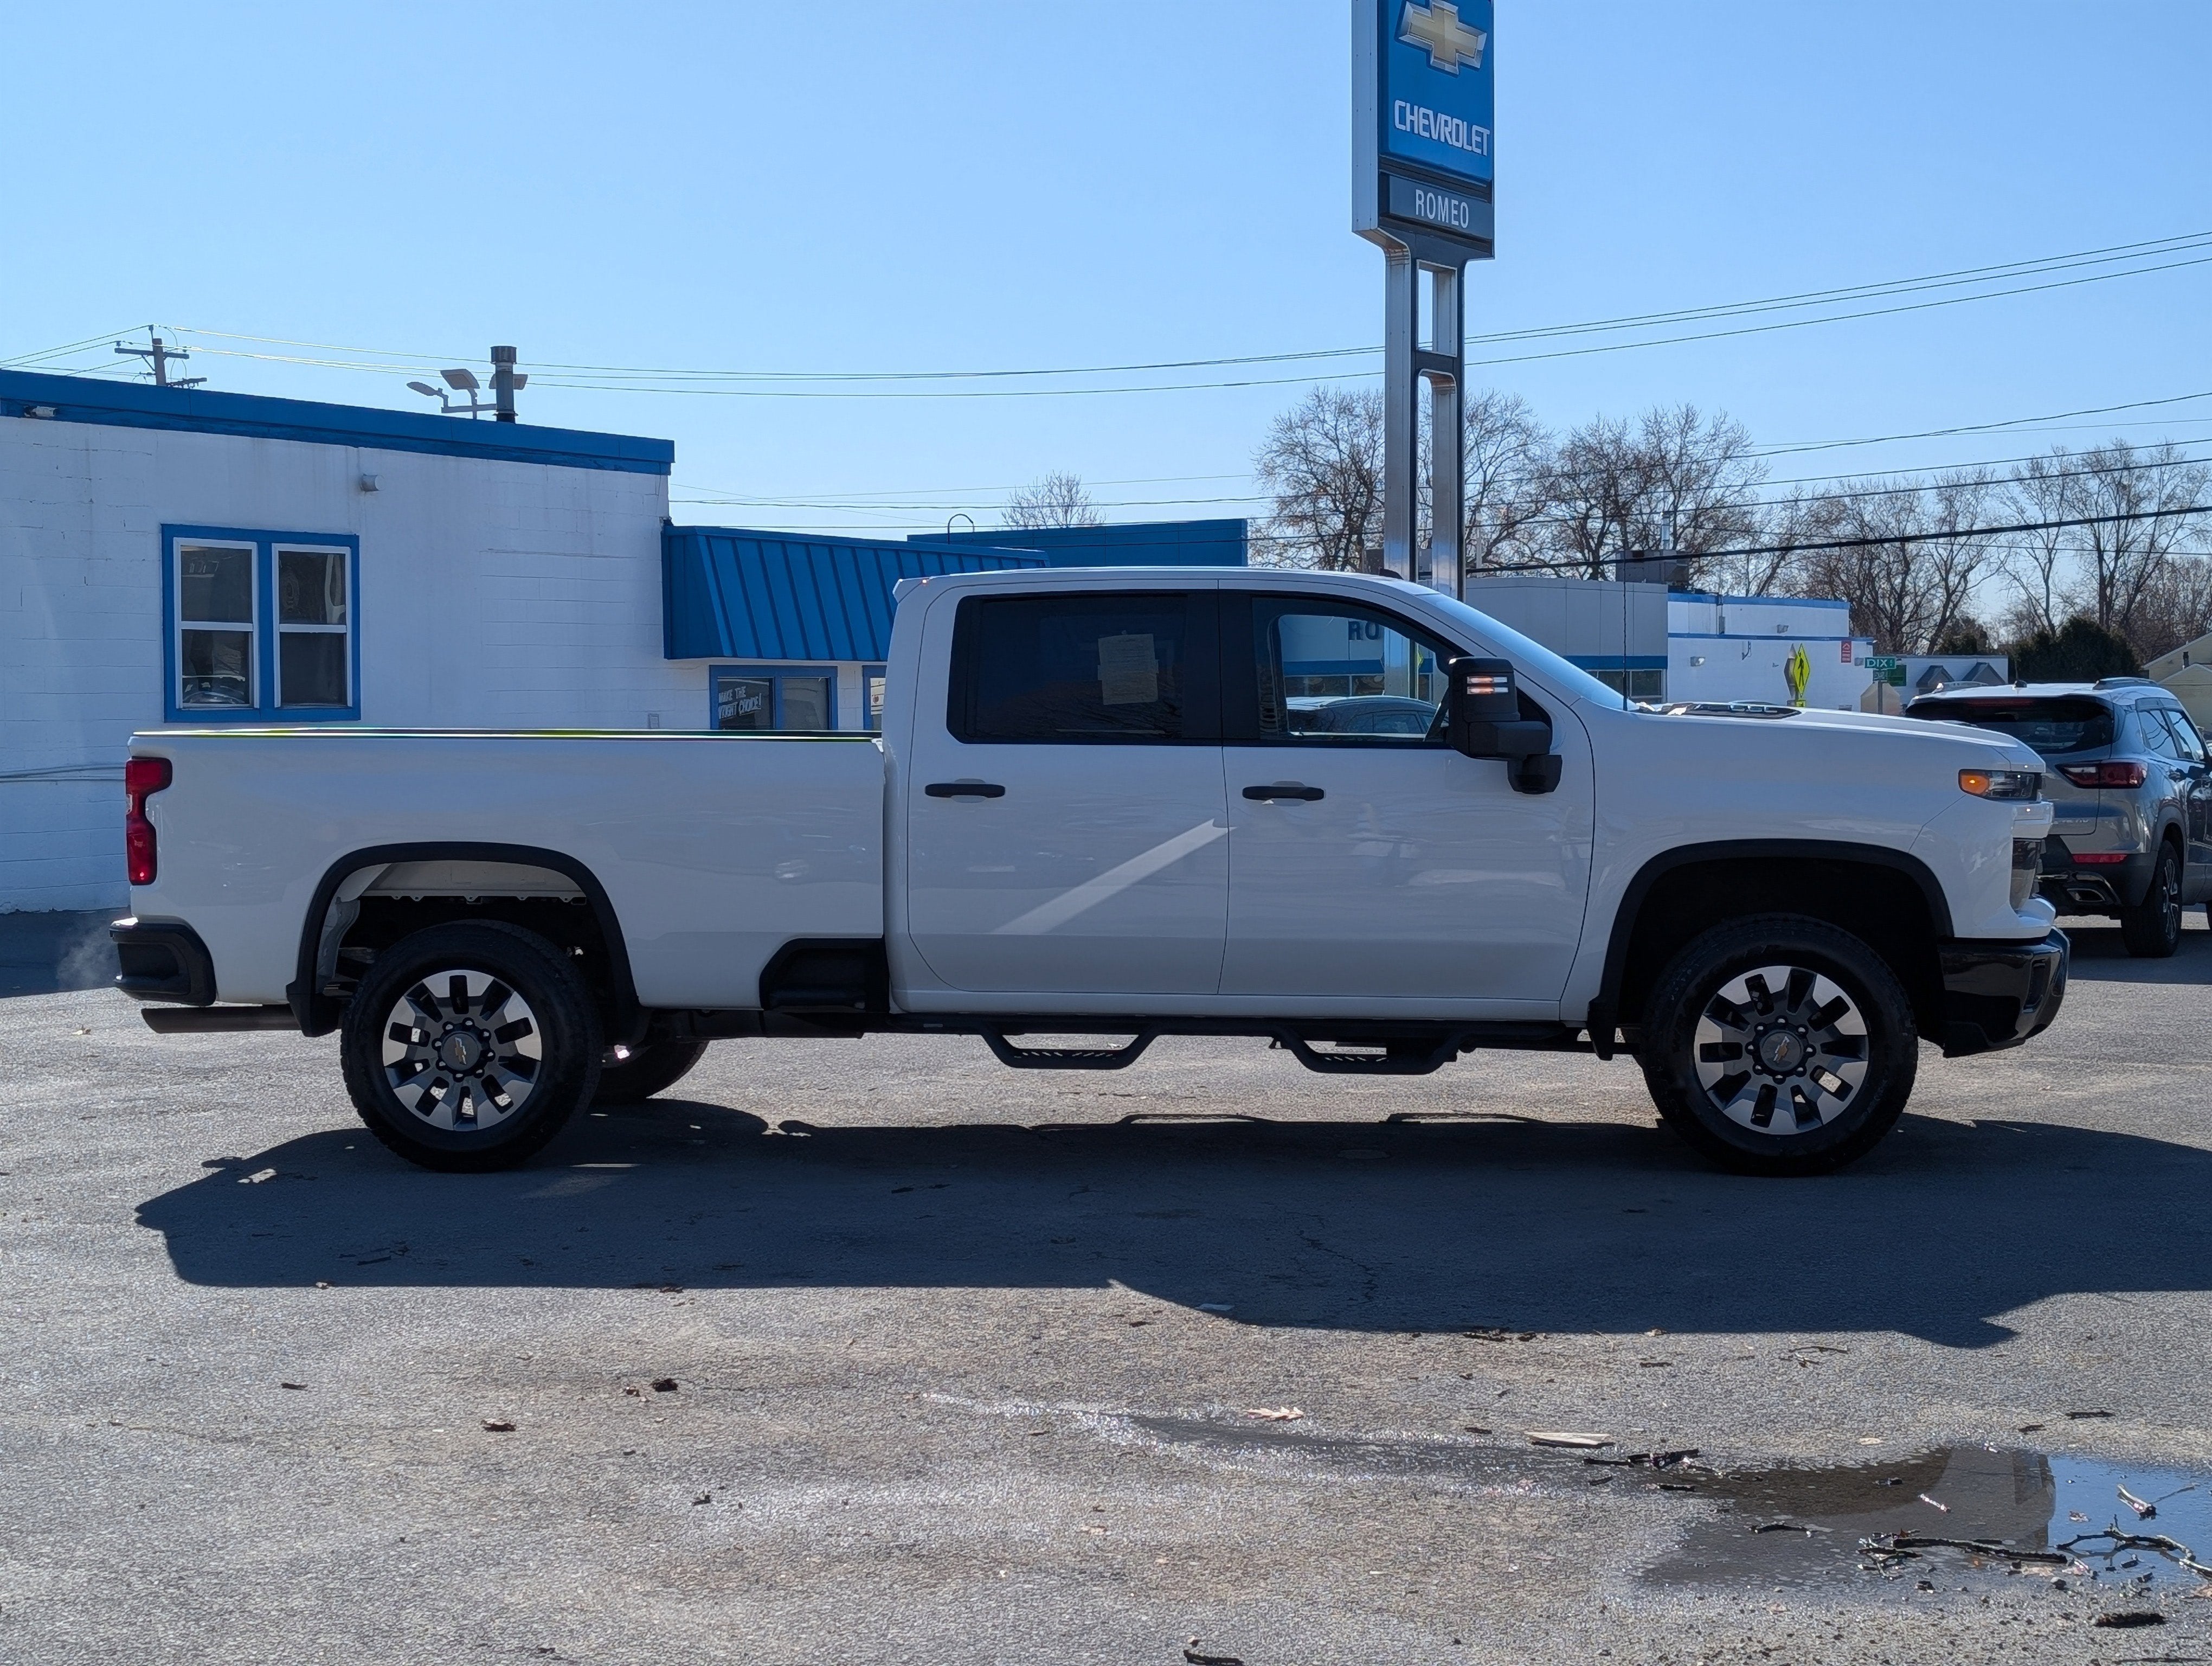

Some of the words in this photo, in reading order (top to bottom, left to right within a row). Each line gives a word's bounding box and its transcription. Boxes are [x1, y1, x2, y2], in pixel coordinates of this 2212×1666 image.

[1394, 100, 1490, 156] CHEVROLET
[1416, 189, 1469, 228] ROMEO
[1867, 658, 1887, 667] DIX
